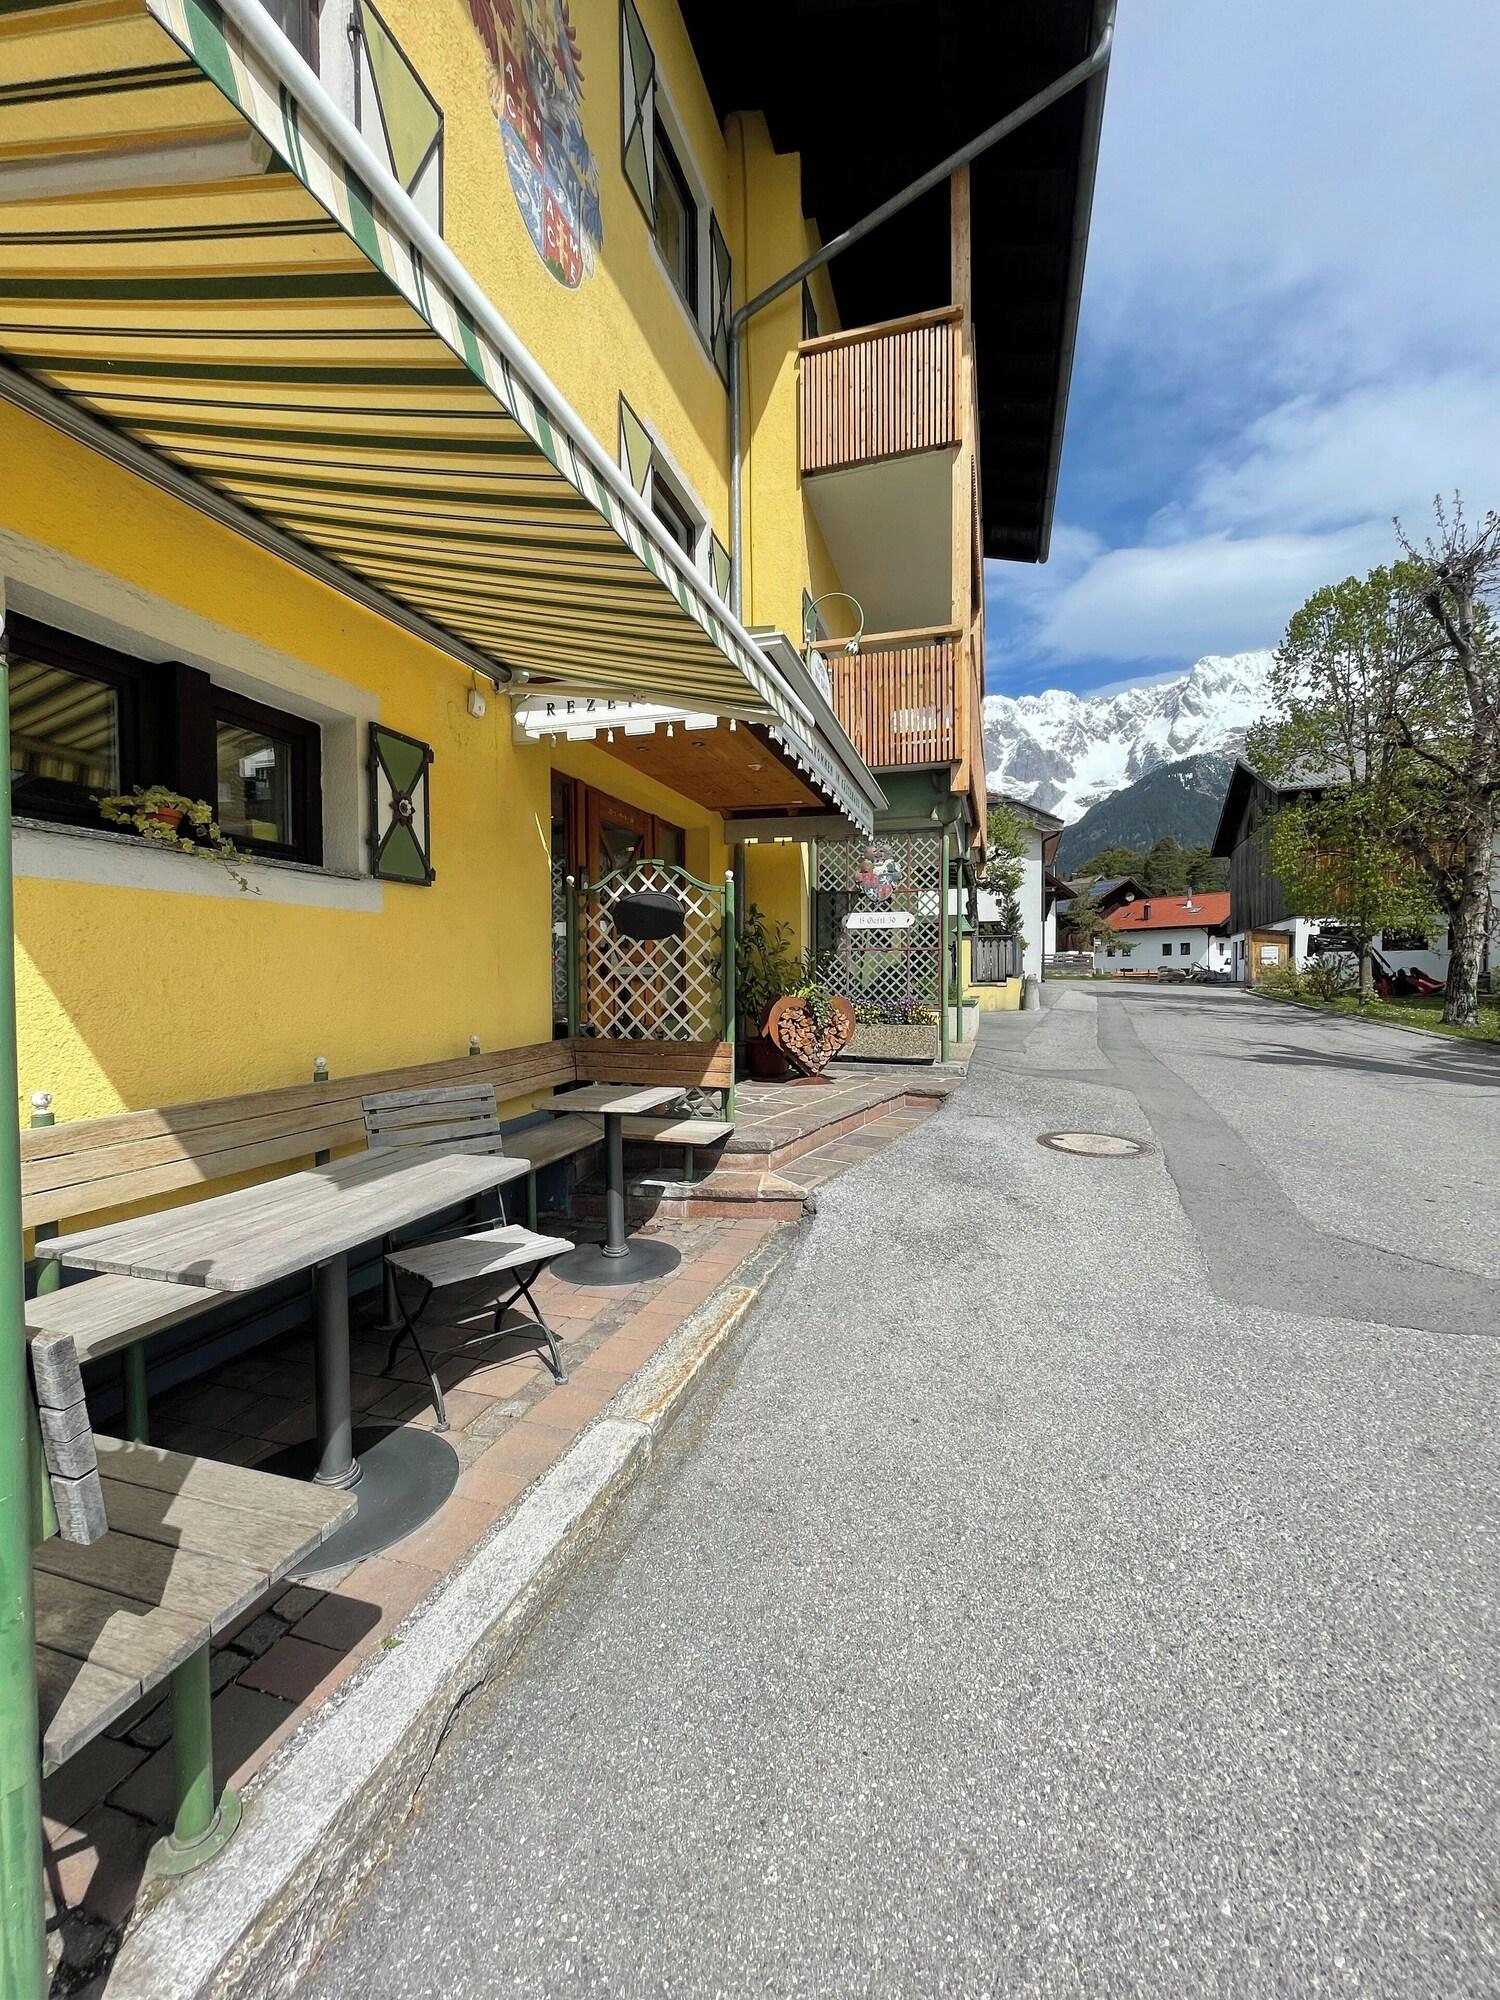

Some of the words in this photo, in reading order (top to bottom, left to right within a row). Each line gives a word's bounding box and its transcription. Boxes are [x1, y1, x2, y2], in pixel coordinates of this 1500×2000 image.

[506, 93, 516, 118] C
[546, 197, 554, 220] A
[547, 224, 556, 248] C
